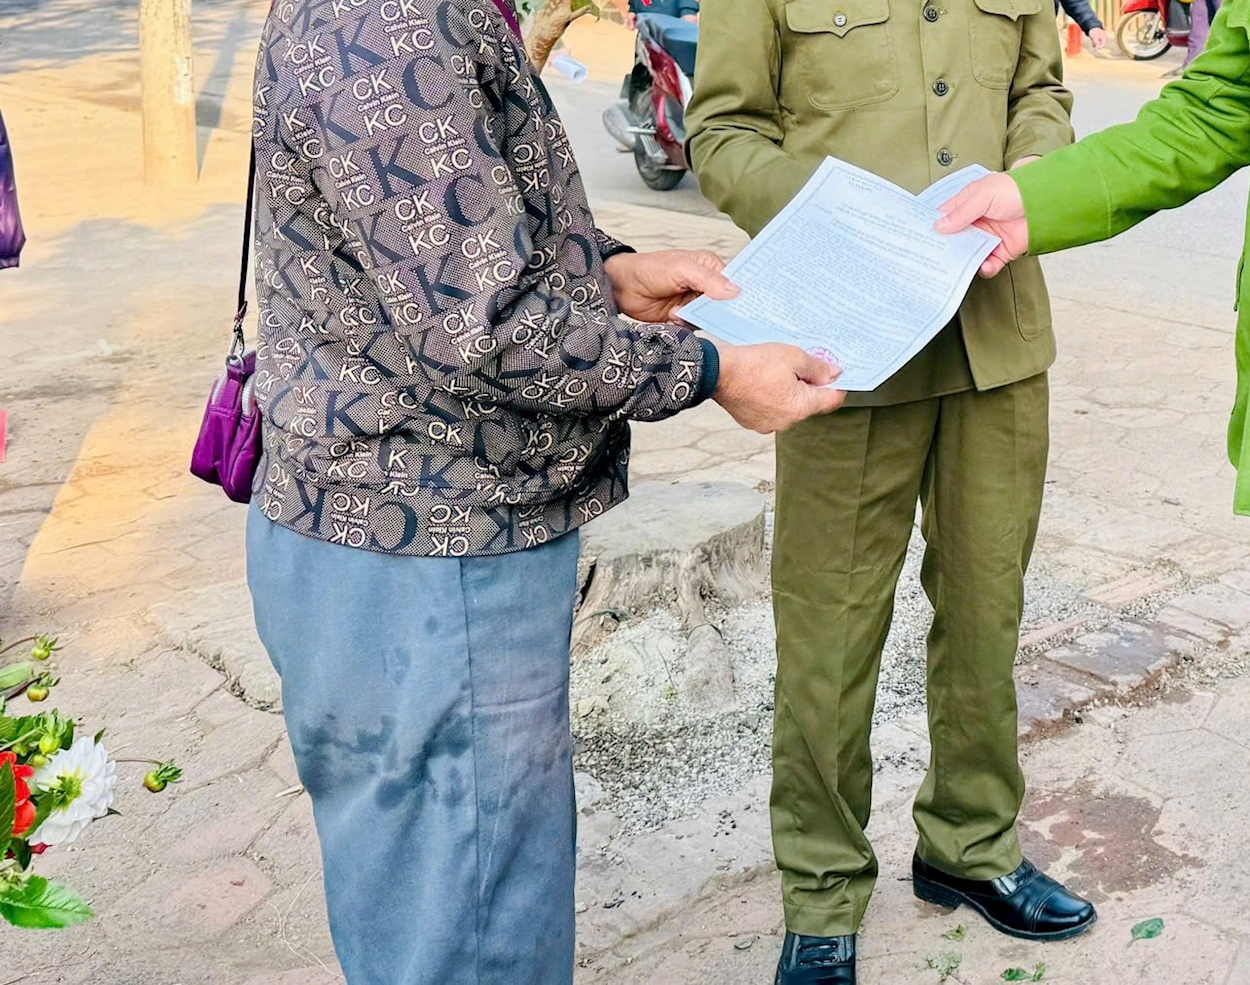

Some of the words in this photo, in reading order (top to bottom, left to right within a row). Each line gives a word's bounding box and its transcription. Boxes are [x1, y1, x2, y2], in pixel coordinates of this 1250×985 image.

[291, 34, 326, 65] CK
[390, 28, 435, 57] KC
[298, 65, 336, 97] KC
[352, 69, 393, 101] CK
[364, 103, 407, 136] KC
[419, 115, 459, 143] CK
[329, 150, 360, 178] CK
[430, 148, 473, 178] KC
[513, 141, 544, 164] KC
[522, 168, 550, 193] CK
[341, 184, 375, 211] KC
[395, 190, 436, 221] CK
[408, 224, 450, 256] KC
[461, 229, 501, 259] CK
[377, 270, 407, 294] CK
[475, 260, 516, 292] KC
[390, 302, 423, 326] KC
[443, 304, 479, 334] CK
[512, 309, 544, 345] CK
[459, 334, 497, 364] KC
[339, 364, 381, 386] KC
[601, 346, 627, 384] CK
[522, 373, 559, 399] CK
[550, 378, 588, 408] KC
[672, 359, 696, 402] KC
[290, 416, 317, 437] KC
[428, 421, 463, 445] CK
[327, 460, 369, 478] KC
[333, 493, 370, 516] KC
[430, 504, 473, 524] KC
[578, 497, 604, 522] CK
[330, 523, 366, 547] CK
[429, 536, 470, 556] CK
[522, 525, 548, 548] CK
